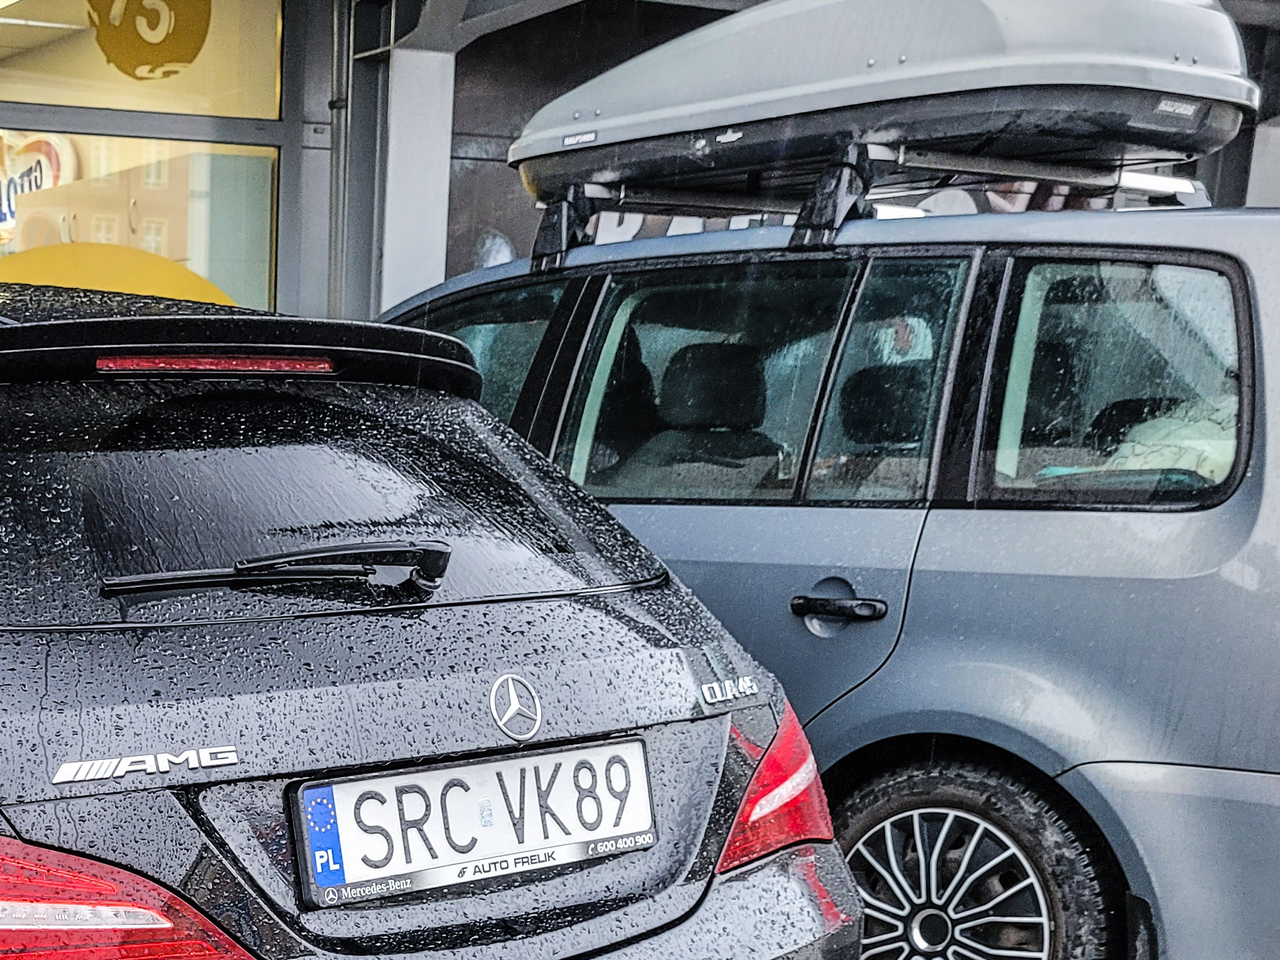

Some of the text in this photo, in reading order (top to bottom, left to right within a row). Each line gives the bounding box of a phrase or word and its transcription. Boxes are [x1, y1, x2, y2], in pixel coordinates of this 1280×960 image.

[113, 745, 239, 778] AMG
[354, 754, 631, 869] SRC VK89
[597, 833, 653, 853] 600 400 900
[315, 849, 340, 873] PL
[473, 851, 556, 876] AUTO FRELIK
[341, 878, 412, 899] Mercedes-Benz
